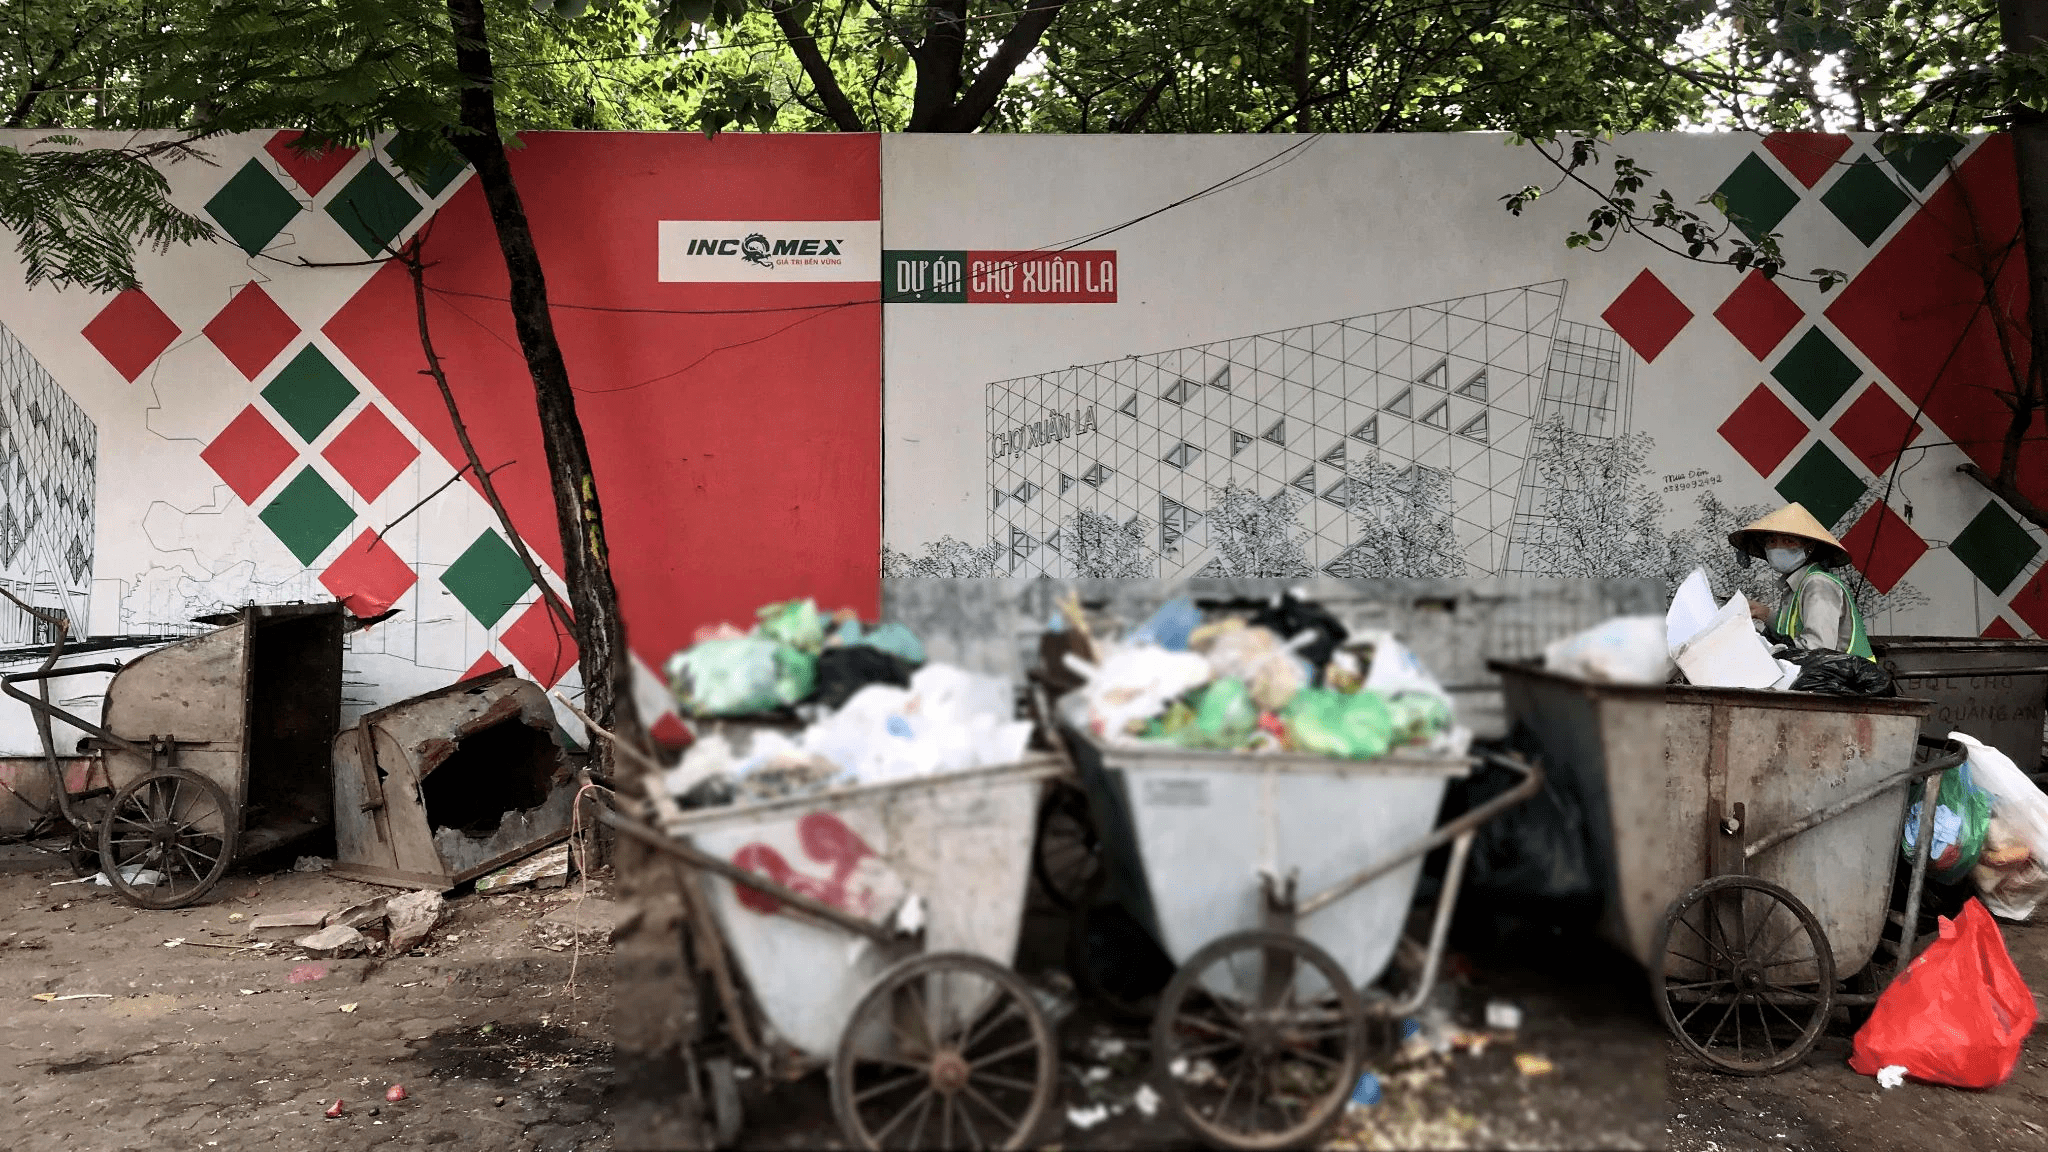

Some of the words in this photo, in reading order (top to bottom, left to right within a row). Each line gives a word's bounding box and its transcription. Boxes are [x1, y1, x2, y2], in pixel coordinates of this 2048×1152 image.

[687, 235, 844, 262] INCOMEX
[897, 259, 929, 299] DỰ
[933, 256, 961, 293] ÁN
[972, 260, 1018, 299] CHỢ
[1022, 256, 1080, 293] XUÂN
[1085, 260, 1114, 293] LA
[1027, 408, 1071, 449] XUÂN
[1075, 405, 1097, 435] LA
